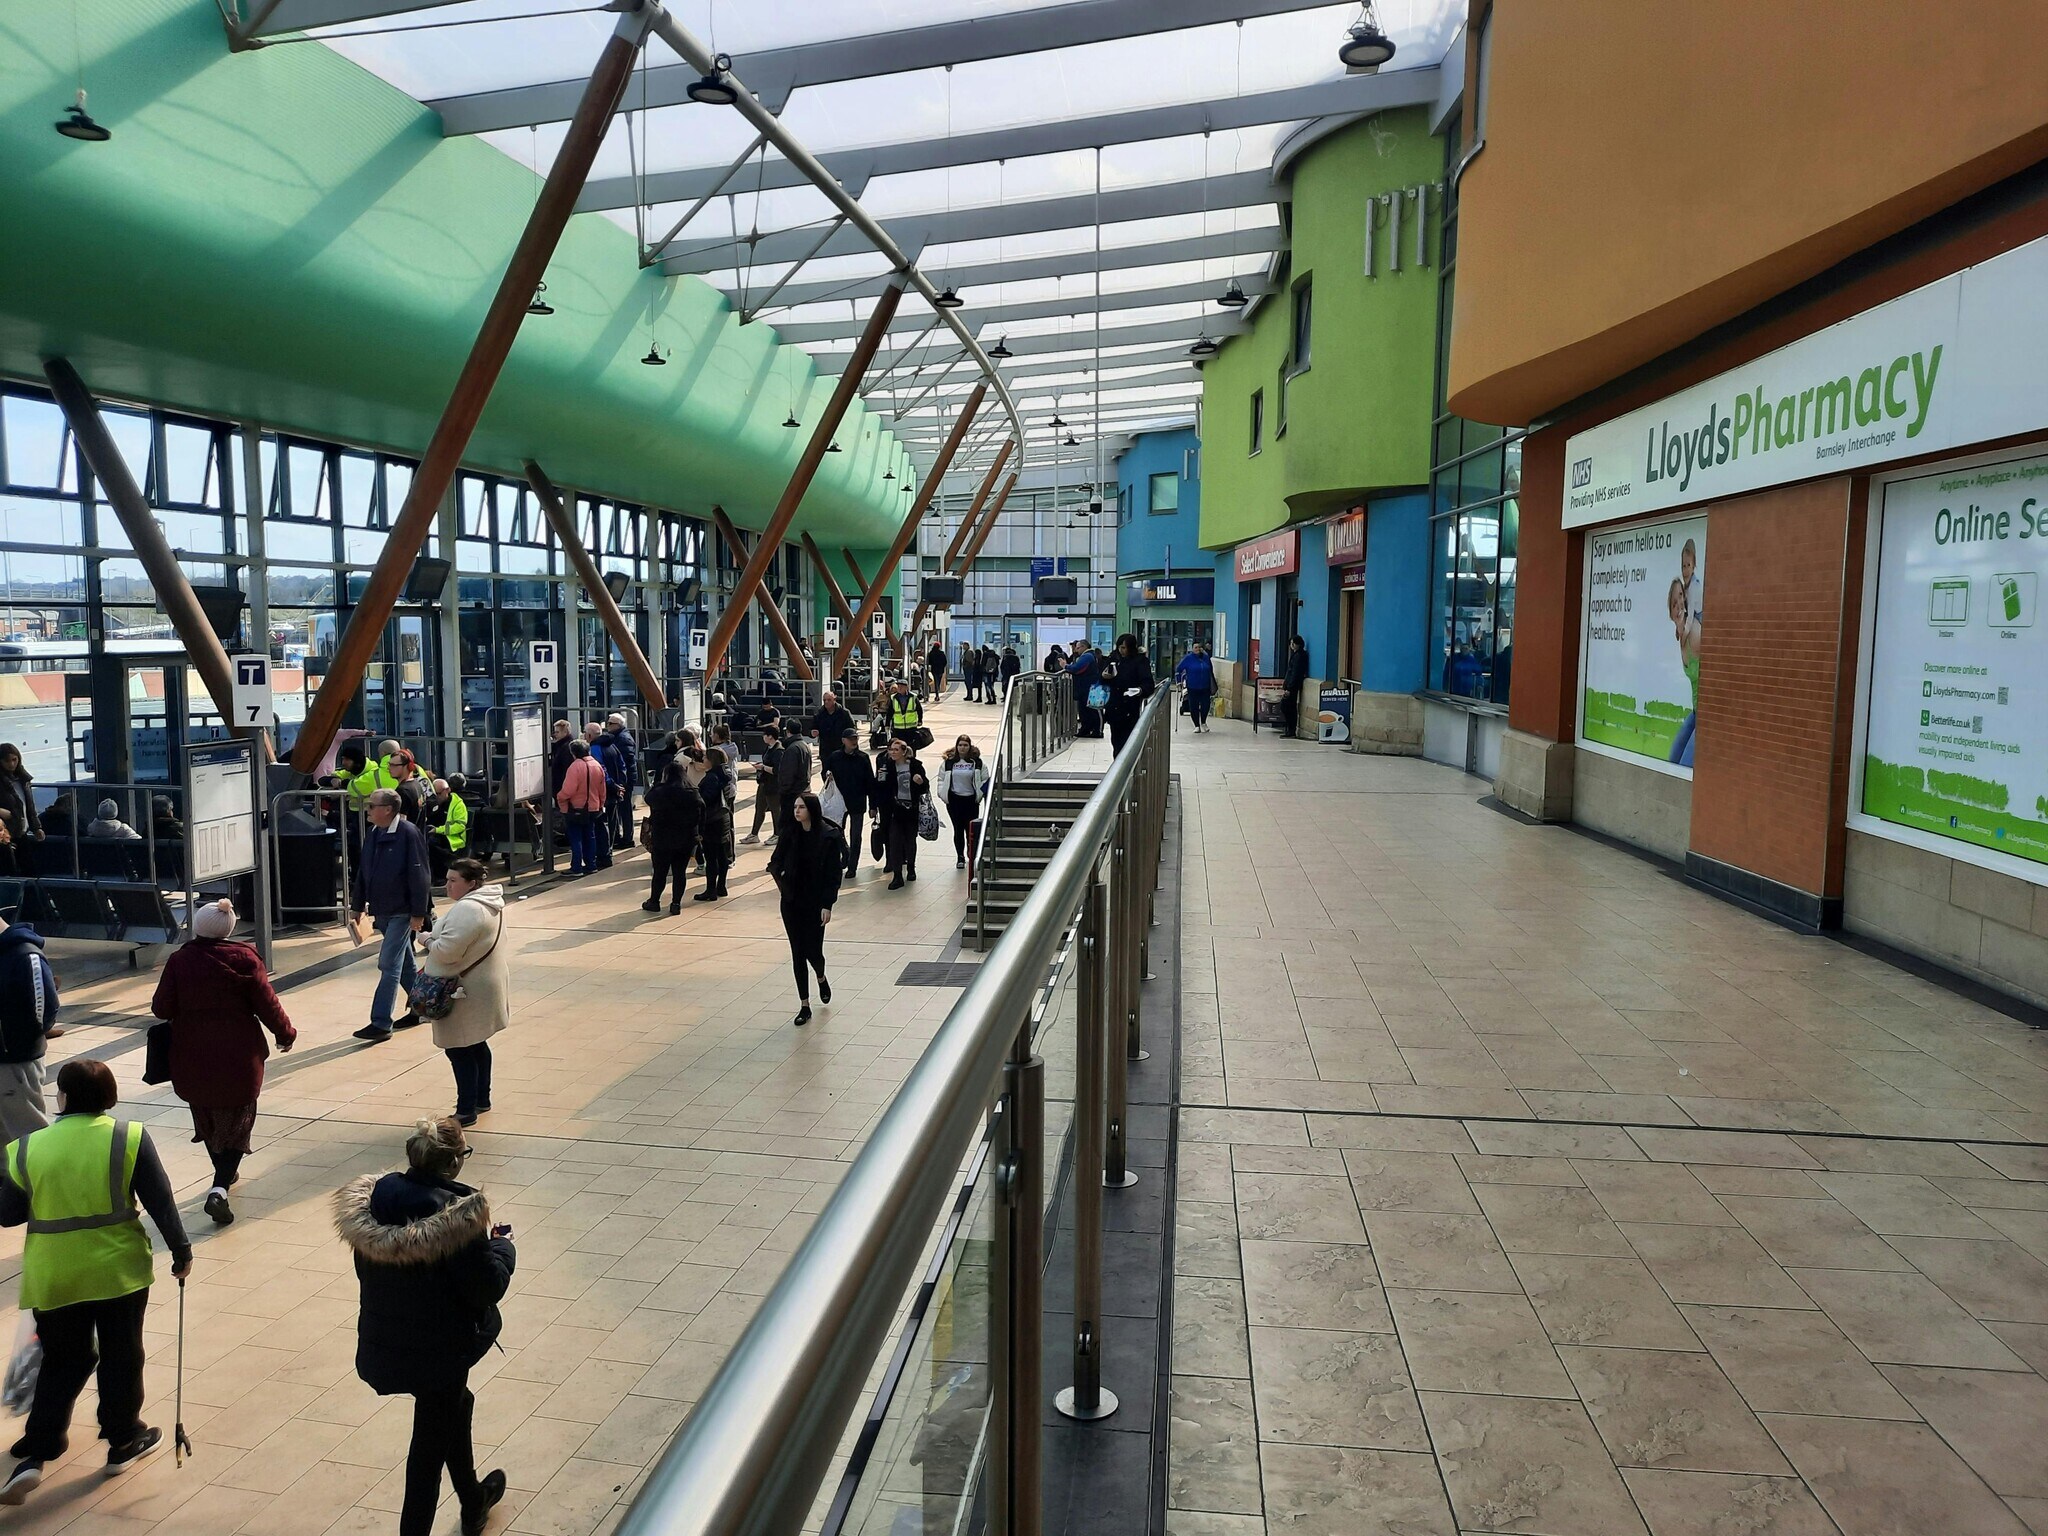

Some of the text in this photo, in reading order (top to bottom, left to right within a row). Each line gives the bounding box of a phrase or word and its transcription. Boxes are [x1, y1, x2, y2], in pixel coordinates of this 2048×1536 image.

[1645, 344, 1943, 492] LloydsPharmacy
[1816, 430, 1896, 459] Barnsley Interchange
[1573, 459, 1592, 487] NHS
[1939, 480, 1969, 494] Anytime
[1976, 472, 2011, 488] Anyplace
[1570, 481, 1631, 509] Providing NHS services
[1935, 504, 2010, 545] Online
[1594, 531, 1672, 562] Say a warm hello to a
[1241, 548, 1286, 575] Select Convenience
[1592, 564, 1647, 589] completely new
[1156, 585, 1176, 599] HILL
[1591, 593, 1632, 617] approach to
[1590, 622, 1625, 641] healthcare
[2000, 631, 2017, 639] Online
[695, 658, 702, 667] 5
[1924, 663, 1987, 675] Discover more online at
[539, 677, 549, 690] 6
[1320, 687, 1350, 696] LAVAZZA
[1933, 686, 1996, 701] LloydsPharmacy.com
[246, 705, 260, 721] 7
[1931, 715, 1971, 728] Betterlife.co.uk
[1919, 732, 2021, 754] mobility and independent living aids
[1938, 749, 1962, 761] impaired
[1963, 753, 1975, 762] aids
